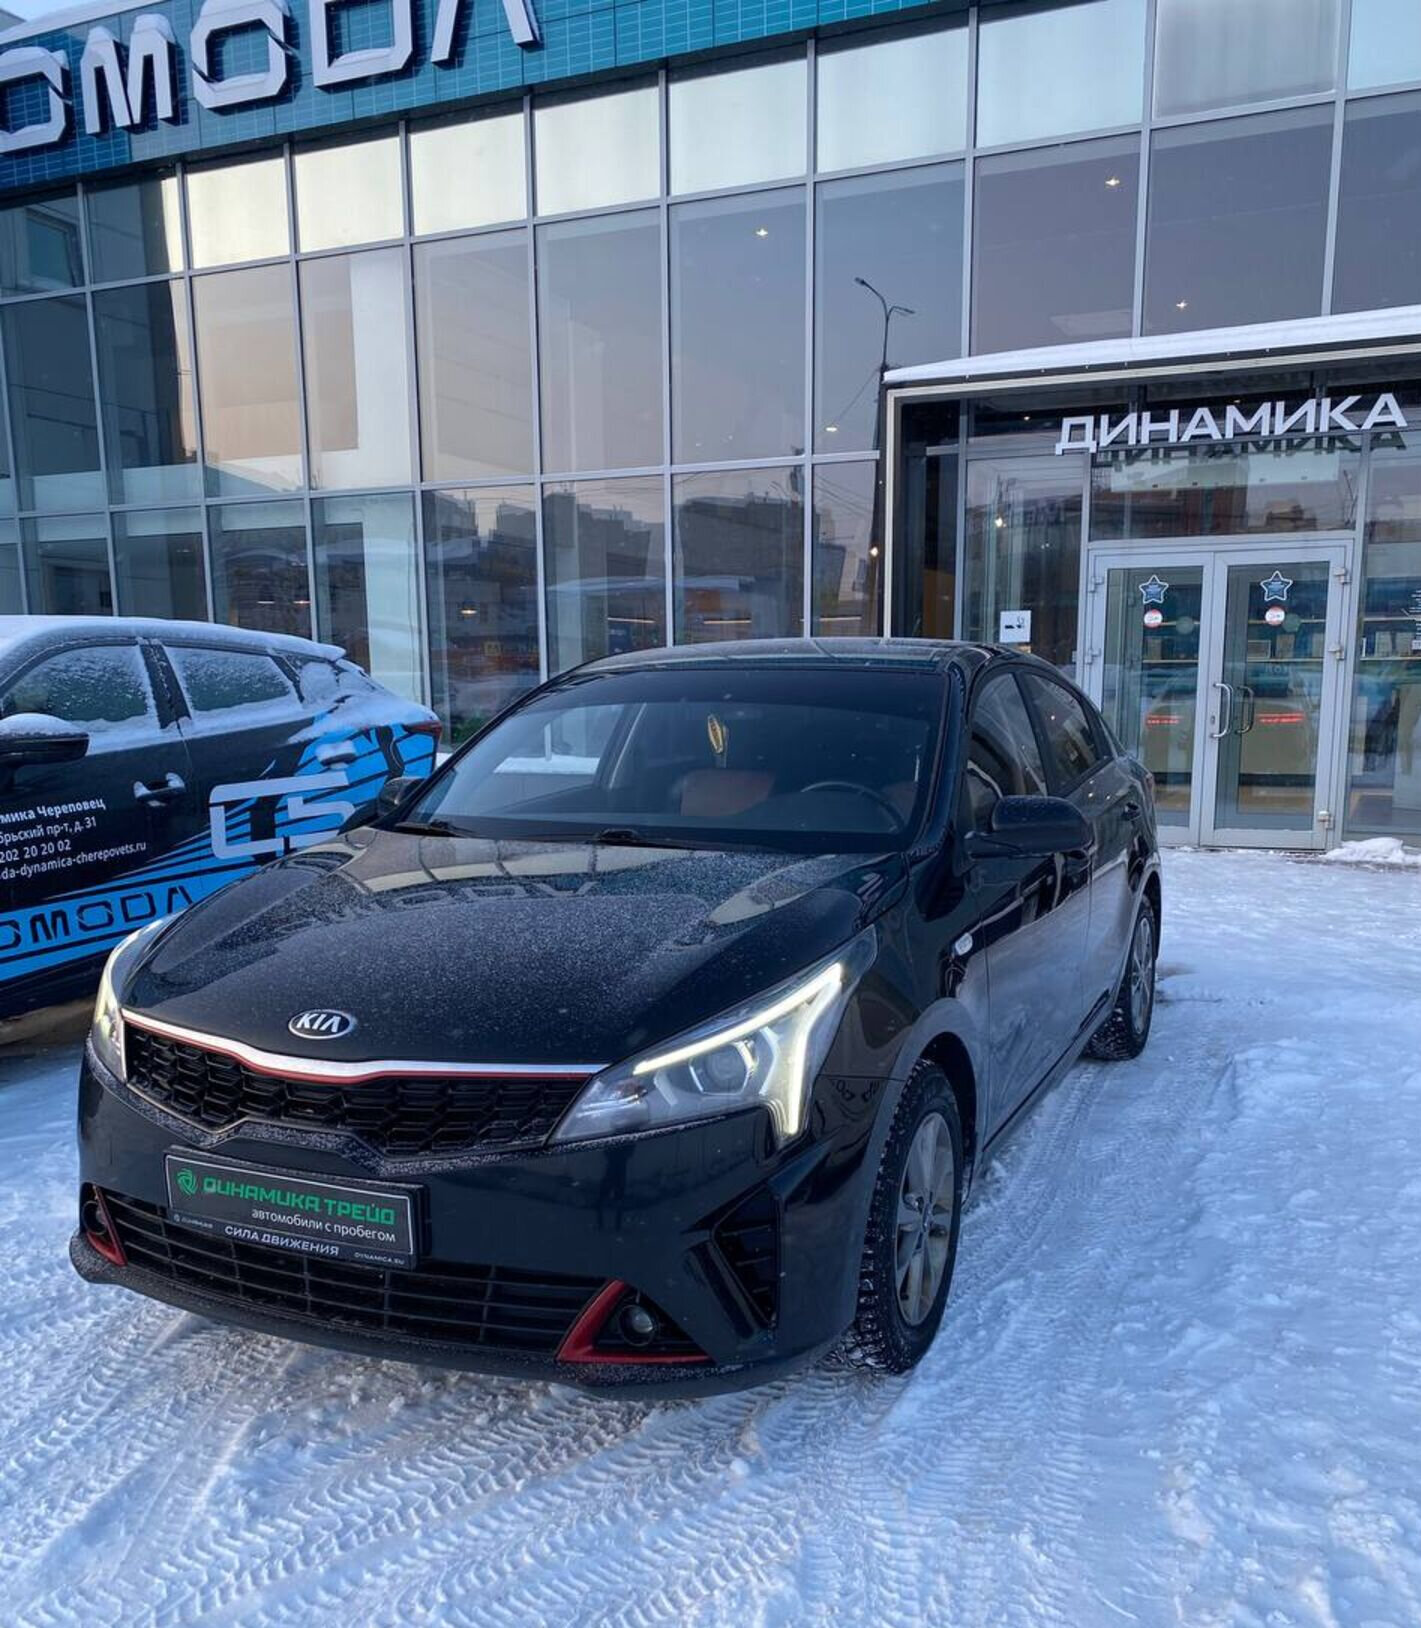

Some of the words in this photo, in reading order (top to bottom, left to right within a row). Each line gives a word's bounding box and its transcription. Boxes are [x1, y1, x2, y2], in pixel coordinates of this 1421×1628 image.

[1055, 392, 1408, 455] ДИНАМИКА
[36, 798, 107, 818] Череповец
[85, 816, 97, 829] 31
[0, 841, 147, 880] da-dynamica-cherepovets.ru
[23, 846, 38, 859] 20
[41, 842, 55, 856] 20
[57, 839, 71, 852] 02
[296, 1013, 342, 1033] KIA
[202, 1177, 320, 1213] ДИНАМИКА
[324, 1199, 395, 1226] ТРЕЙД
[224, 1224, 260, 1241] СИЛА
[261, 1232, 340, 1256] ДВИЖЕНИЯ
[251, 1208, 323, 1232] автомобили
[324, 1222, 332, 1232] с
[334, 1223, 396, 1243] пробегом
